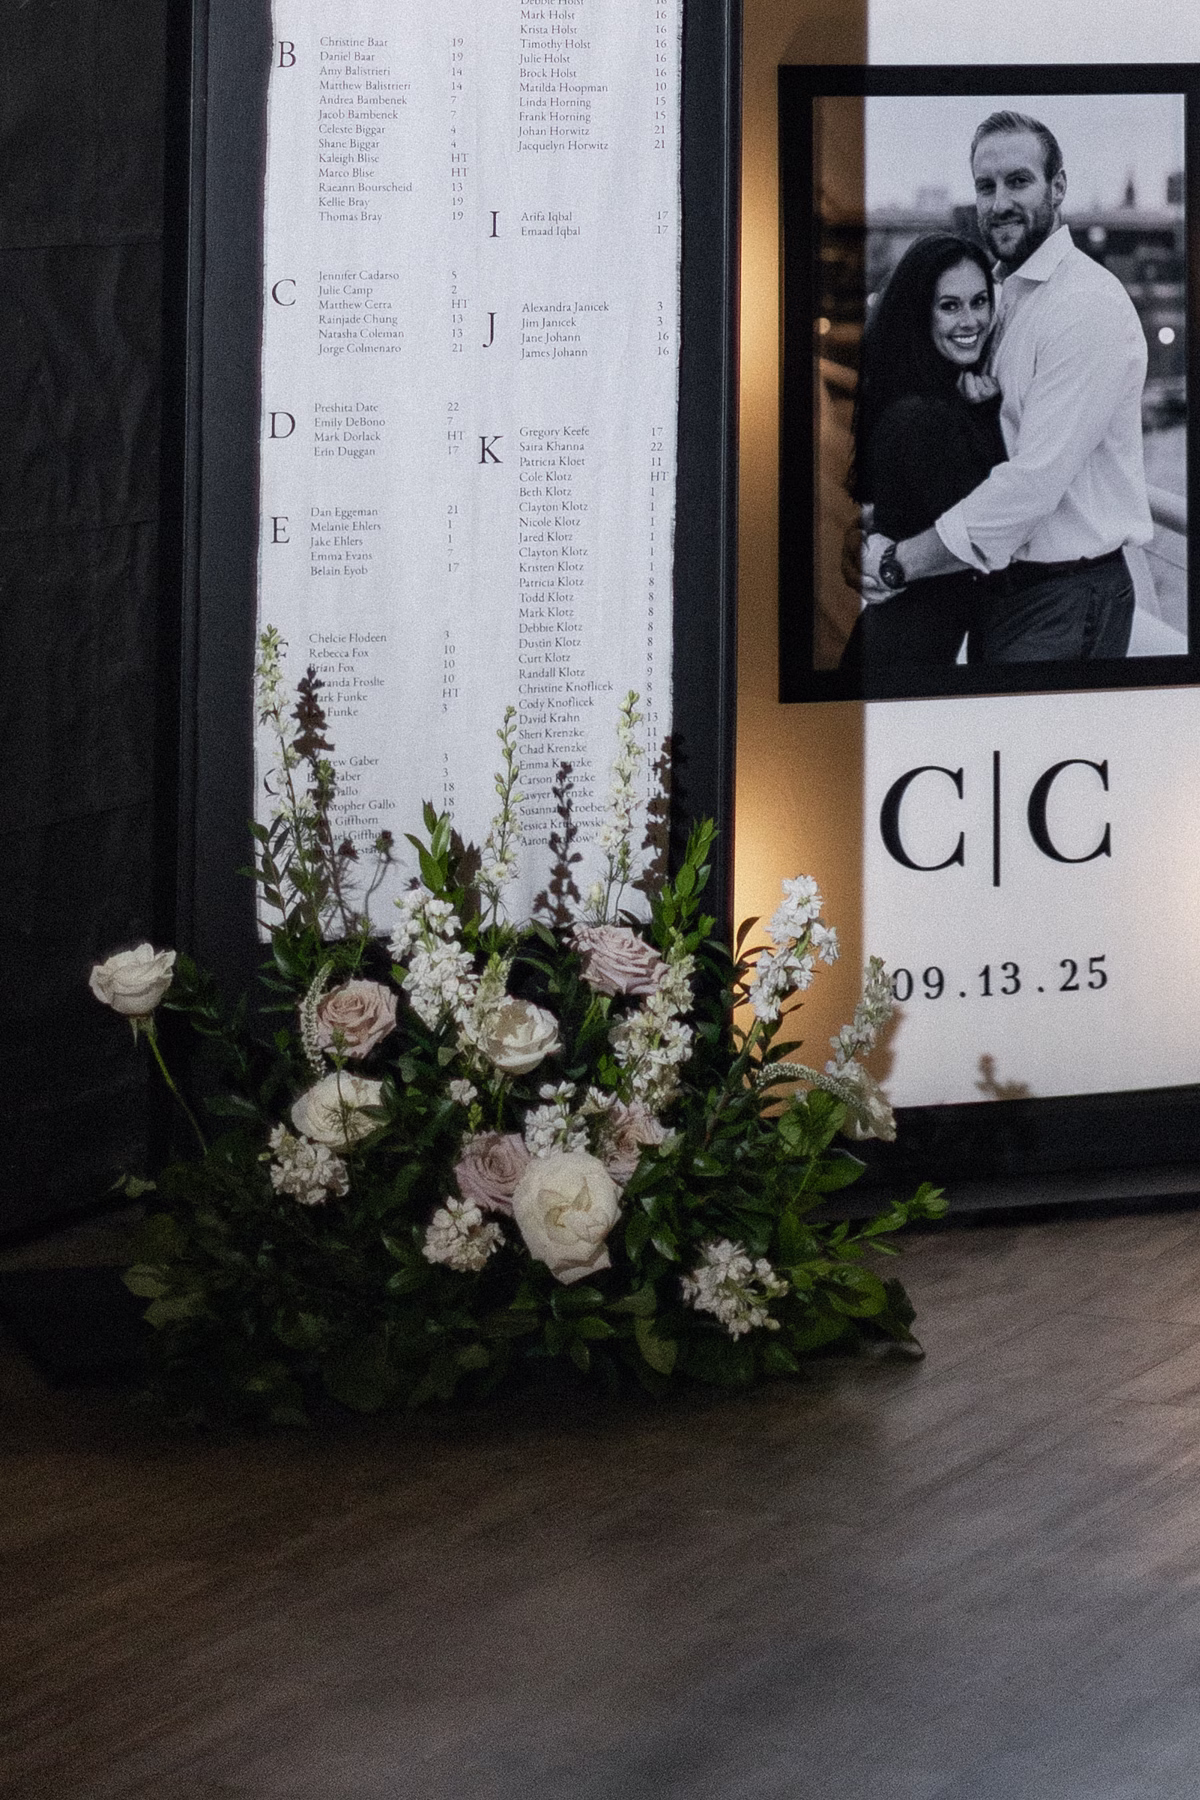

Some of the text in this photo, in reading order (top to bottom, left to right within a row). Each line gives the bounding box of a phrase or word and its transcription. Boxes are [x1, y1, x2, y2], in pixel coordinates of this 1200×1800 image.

[520, 10, 666, 19] Mark Holst 16
[320, 37, 463, 47] Christine Baar 19
[520, 39, 562, 51] Timothy
[565, 39, 591, 49] Holst
[278, 41, 296, 68] B
[319, 96, 456, 105] Andrea Bambenek 7
[519, 97, 666, 109] Linda Horning 15
[518, 140, 665, 153] Jacquelyn Horwitz 21
[319, 168, 468, 177] Marco Blise HT
[319, 183, 463, 192] Raeann Bourscheid 13
[319, 212, 463, 224] Thomas Bray 19
[490, 211, 500, 237] I
[318, 271, 456, 282] Jennifer Cadarso 5
[272, 279, 296, 306] C
[522, 302, 663, 313] Alexandra Janicek 3
[319, 329, 463, 339] Natasha Coleman 13
[483, 312, 497, 347] J
[318, 344, 463, 356] Jorge Colmenaro 21
[521, 347, 669, 359] James Johann 16
[269, 412, 296, 439] D
[314, 432, 465, 441] Mark Dorlack HT
[479, 436, 503, 464] K
[520, 442, 663, 451] Saira Khanna 22
[520, 472, 669, 482] Cole Klotz HT
[311, 505, 458, 519] Dan Eggeman 21
[271, 517, 290, 544] E
[310, 645, 455, 658] Rebecca Fox 10
[519, 667, 652, 678] Randall Klotz 9
[519, 712, 657, 724] David Krahn 13
[891, 955, 1108, 1002] 09.13.25
